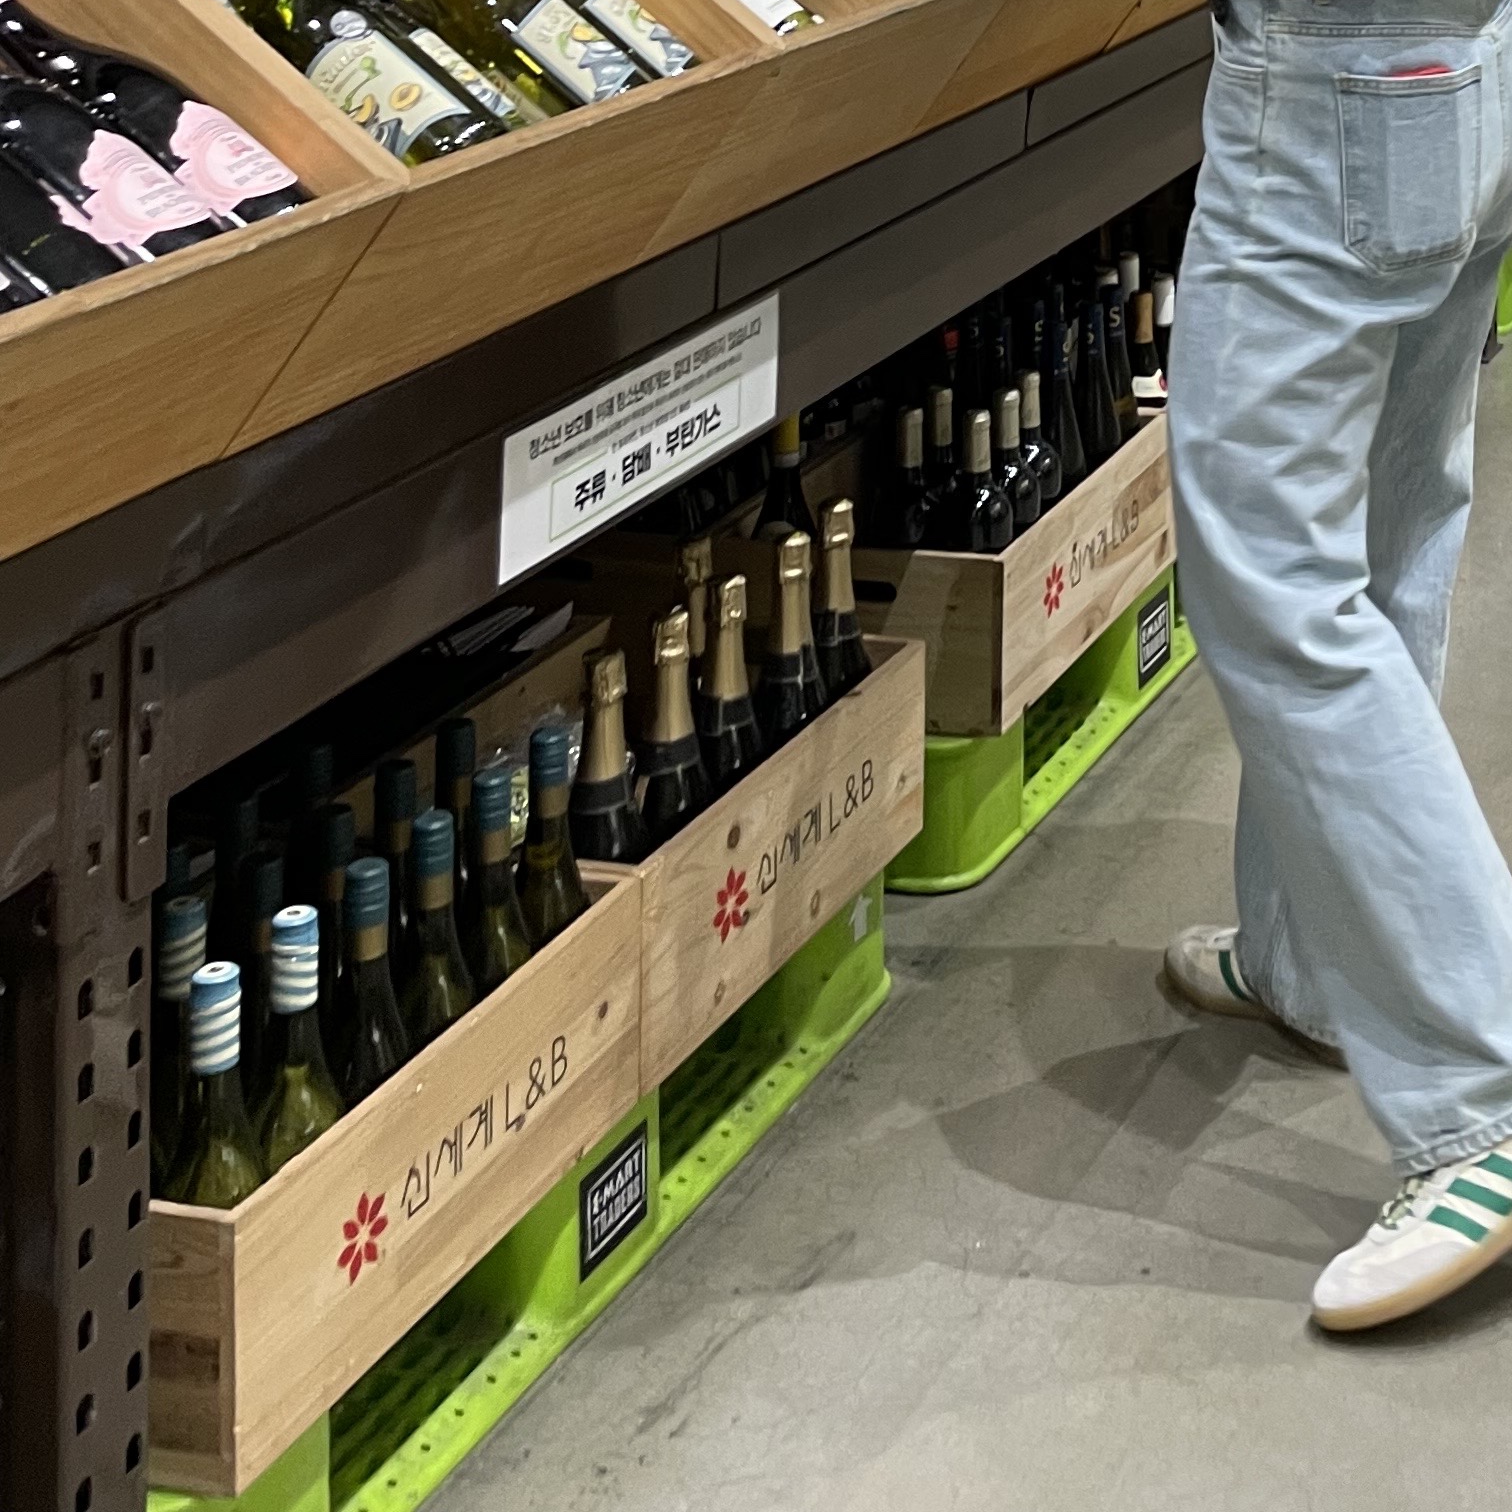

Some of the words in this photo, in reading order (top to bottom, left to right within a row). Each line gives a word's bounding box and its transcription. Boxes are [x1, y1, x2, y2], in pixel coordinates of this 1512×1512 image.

[528, 424, 562, 460] 청소년
[574, 469, 607, 512] 주류
[621, 441, 652, 487] 담배
[665, 403, 721, 458] 부탄가스
[756, 800, 822, 895] 신세계
[829, 759, 874, 834] L&B
[401, 1094, 494, 1220] 신세계
[504, 1035, 568, 1133] L&B
